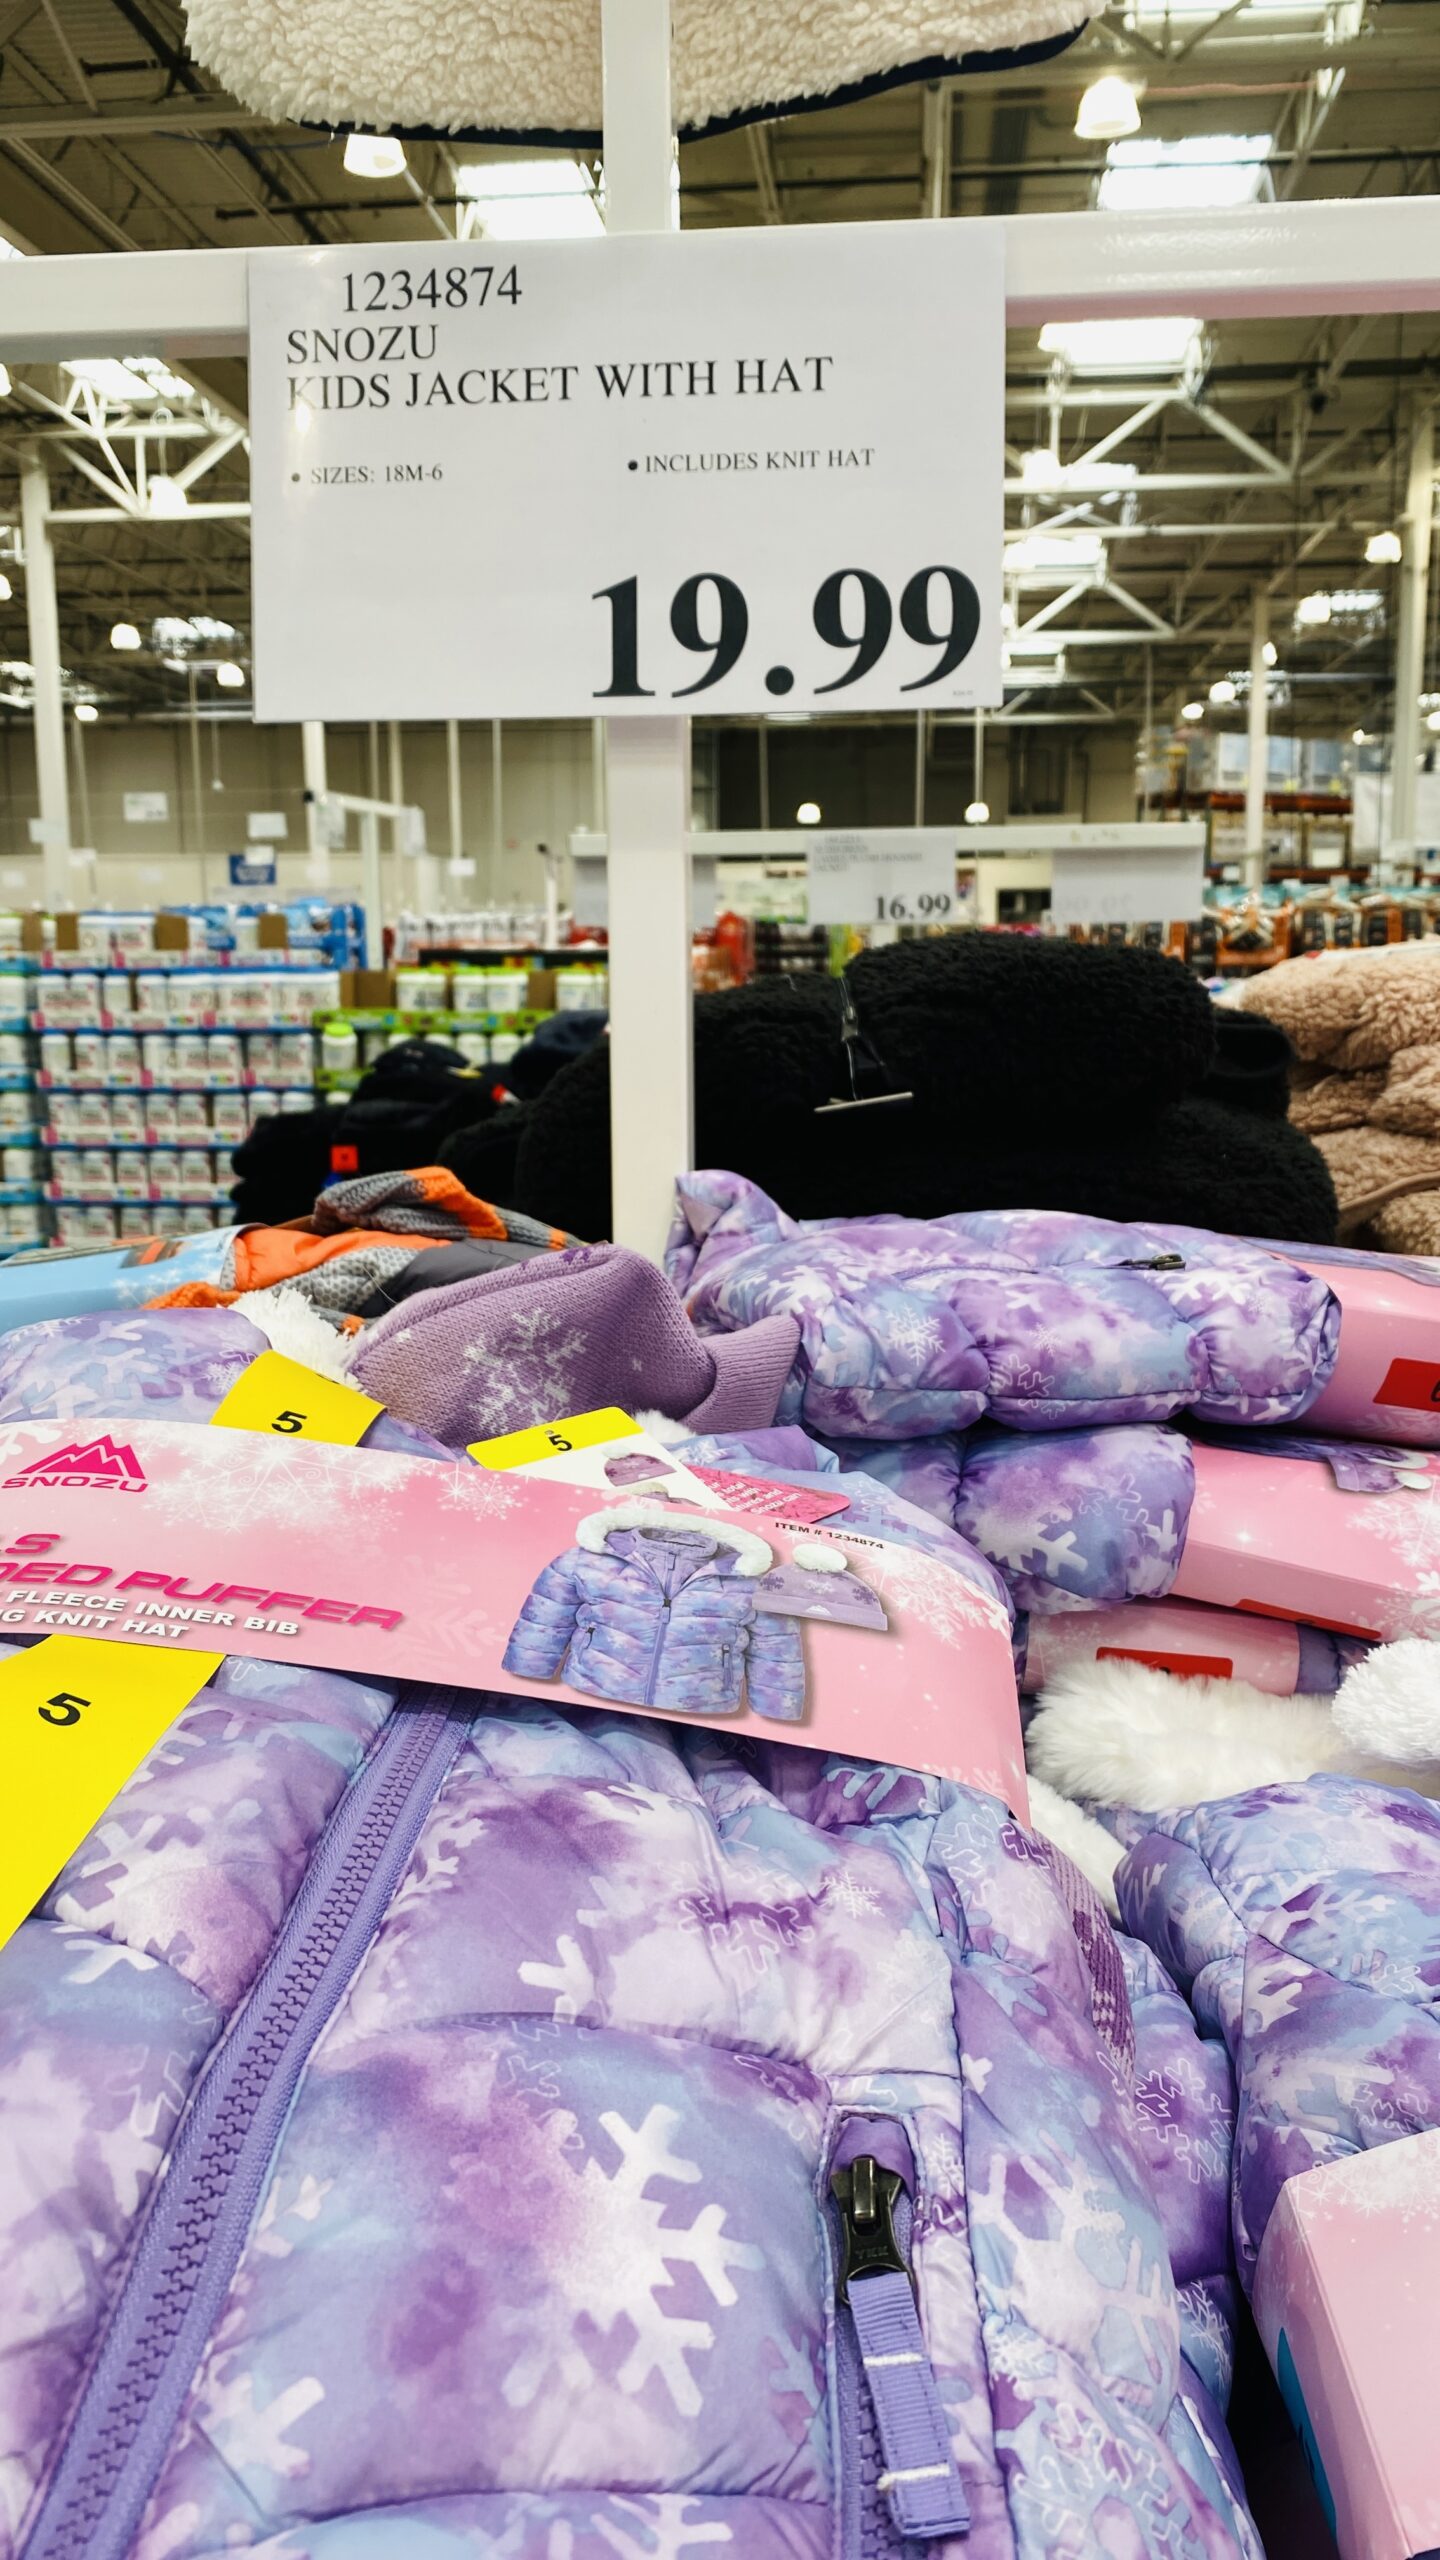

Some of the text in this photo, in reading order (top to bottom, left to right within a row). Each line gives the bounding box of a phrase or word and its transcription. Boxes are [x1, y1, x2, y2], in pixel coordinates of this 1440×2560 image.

[343, 264, 523, 312] 1234874
[286, 324, 439, 364] SNOZU
[286, 356, 834, 411] KIDS JACKET WITH HAT
[310, 464, 443, 485] SIZES: 18M-6
[645, 448, 875, 473] INCLUDES KNIT HAT
[592, 565, 981, 698] 19.99
[876, 894, 951, 920] 16.99
[271, 1410, 307, 1433] 5
[548, 1434, 572, 1451] 5
[1, 1476, 148, 1493] SNOZU
[774, 1522, 811, 1534] ITEM
[826, 1531, 885, 1549] 1234874
[6, 1589, 299, 1635] FLEECE INNER BIB
[115, 1571, 403, 1630] PUFFER
[33, 1610, 116, 1628] KNIT
[121, 1619, 190, 1638] HAT
[38, 1692, 91, 1726] 5
